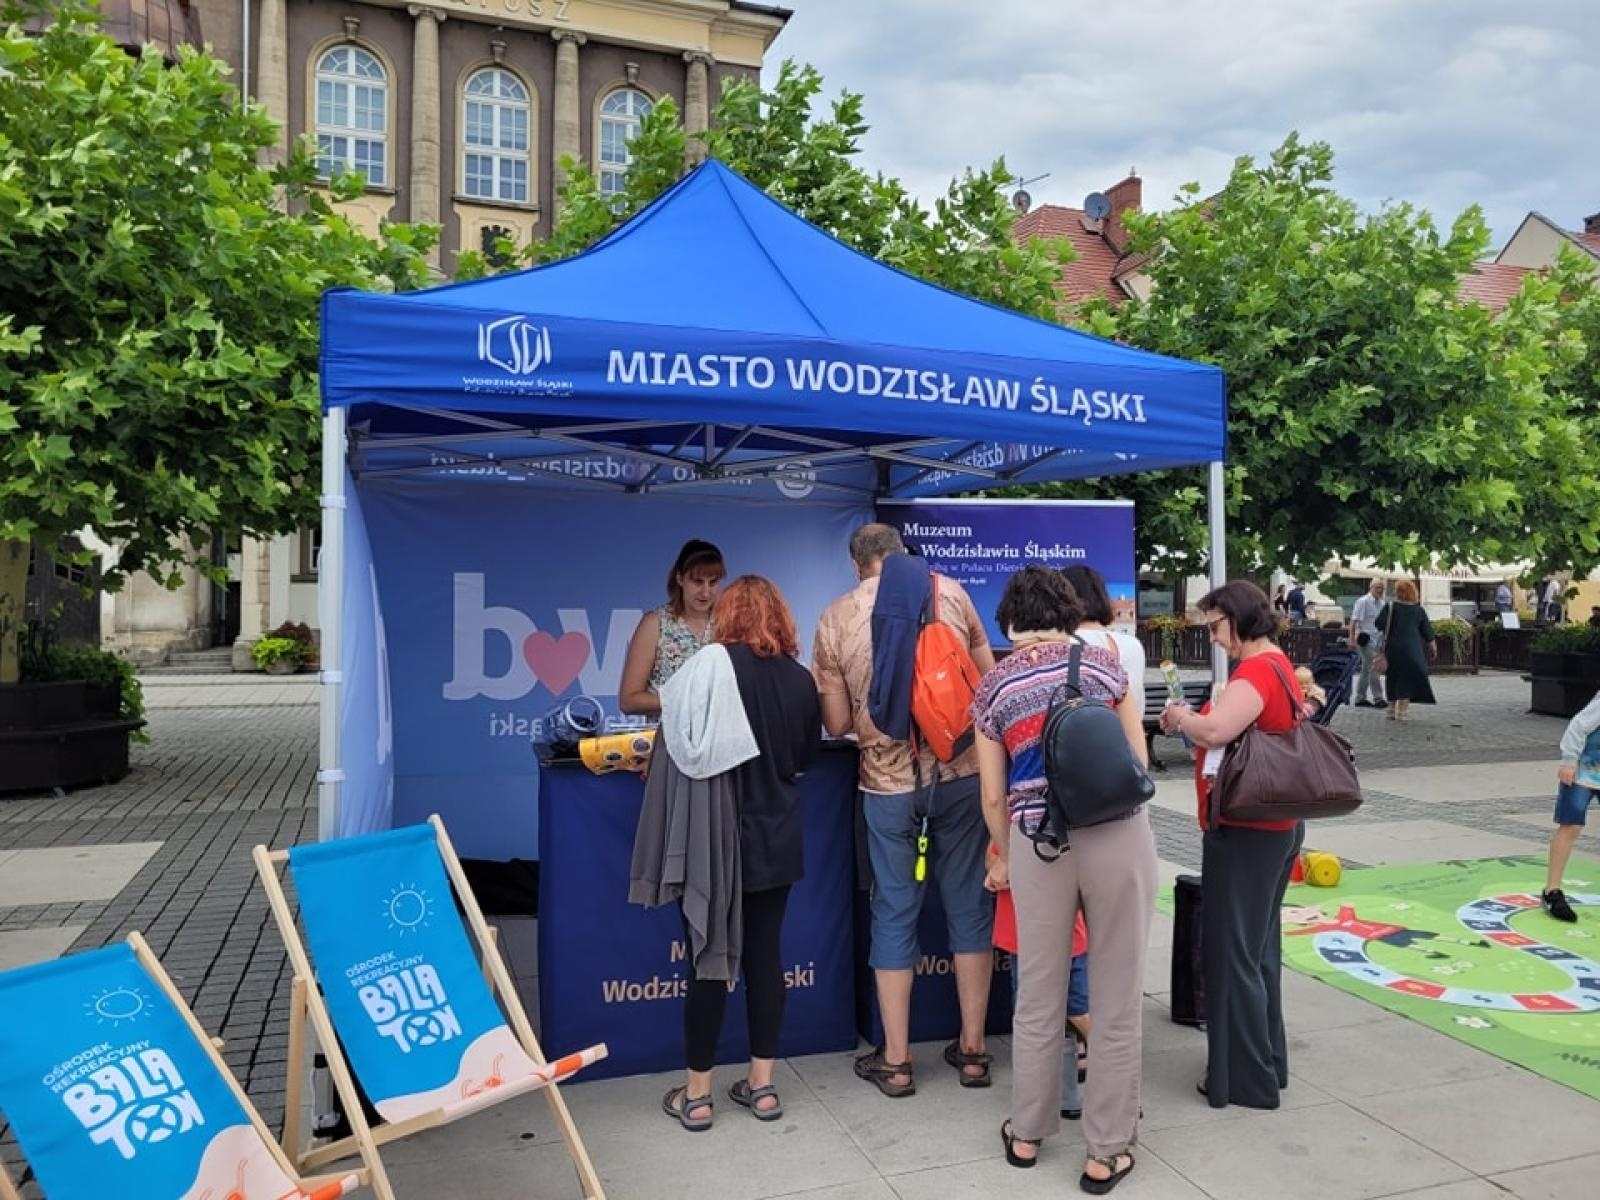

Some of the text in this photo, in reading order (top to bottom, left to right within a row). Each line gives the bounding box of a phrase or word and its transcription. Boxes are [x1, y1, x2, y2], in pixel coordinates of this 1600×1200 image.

[607, 350, 1147, 426] MIASTO WODZISŁAW ŚLĄSKI
[903, 522, 973, 537] Muzeum
[920, 540, 1086, 561] Wodzisławiu Śląskim
[42, 1042, 113, 1086] OŚRODEK
[51, 1040, 151, 1093] REKREACYJNY
